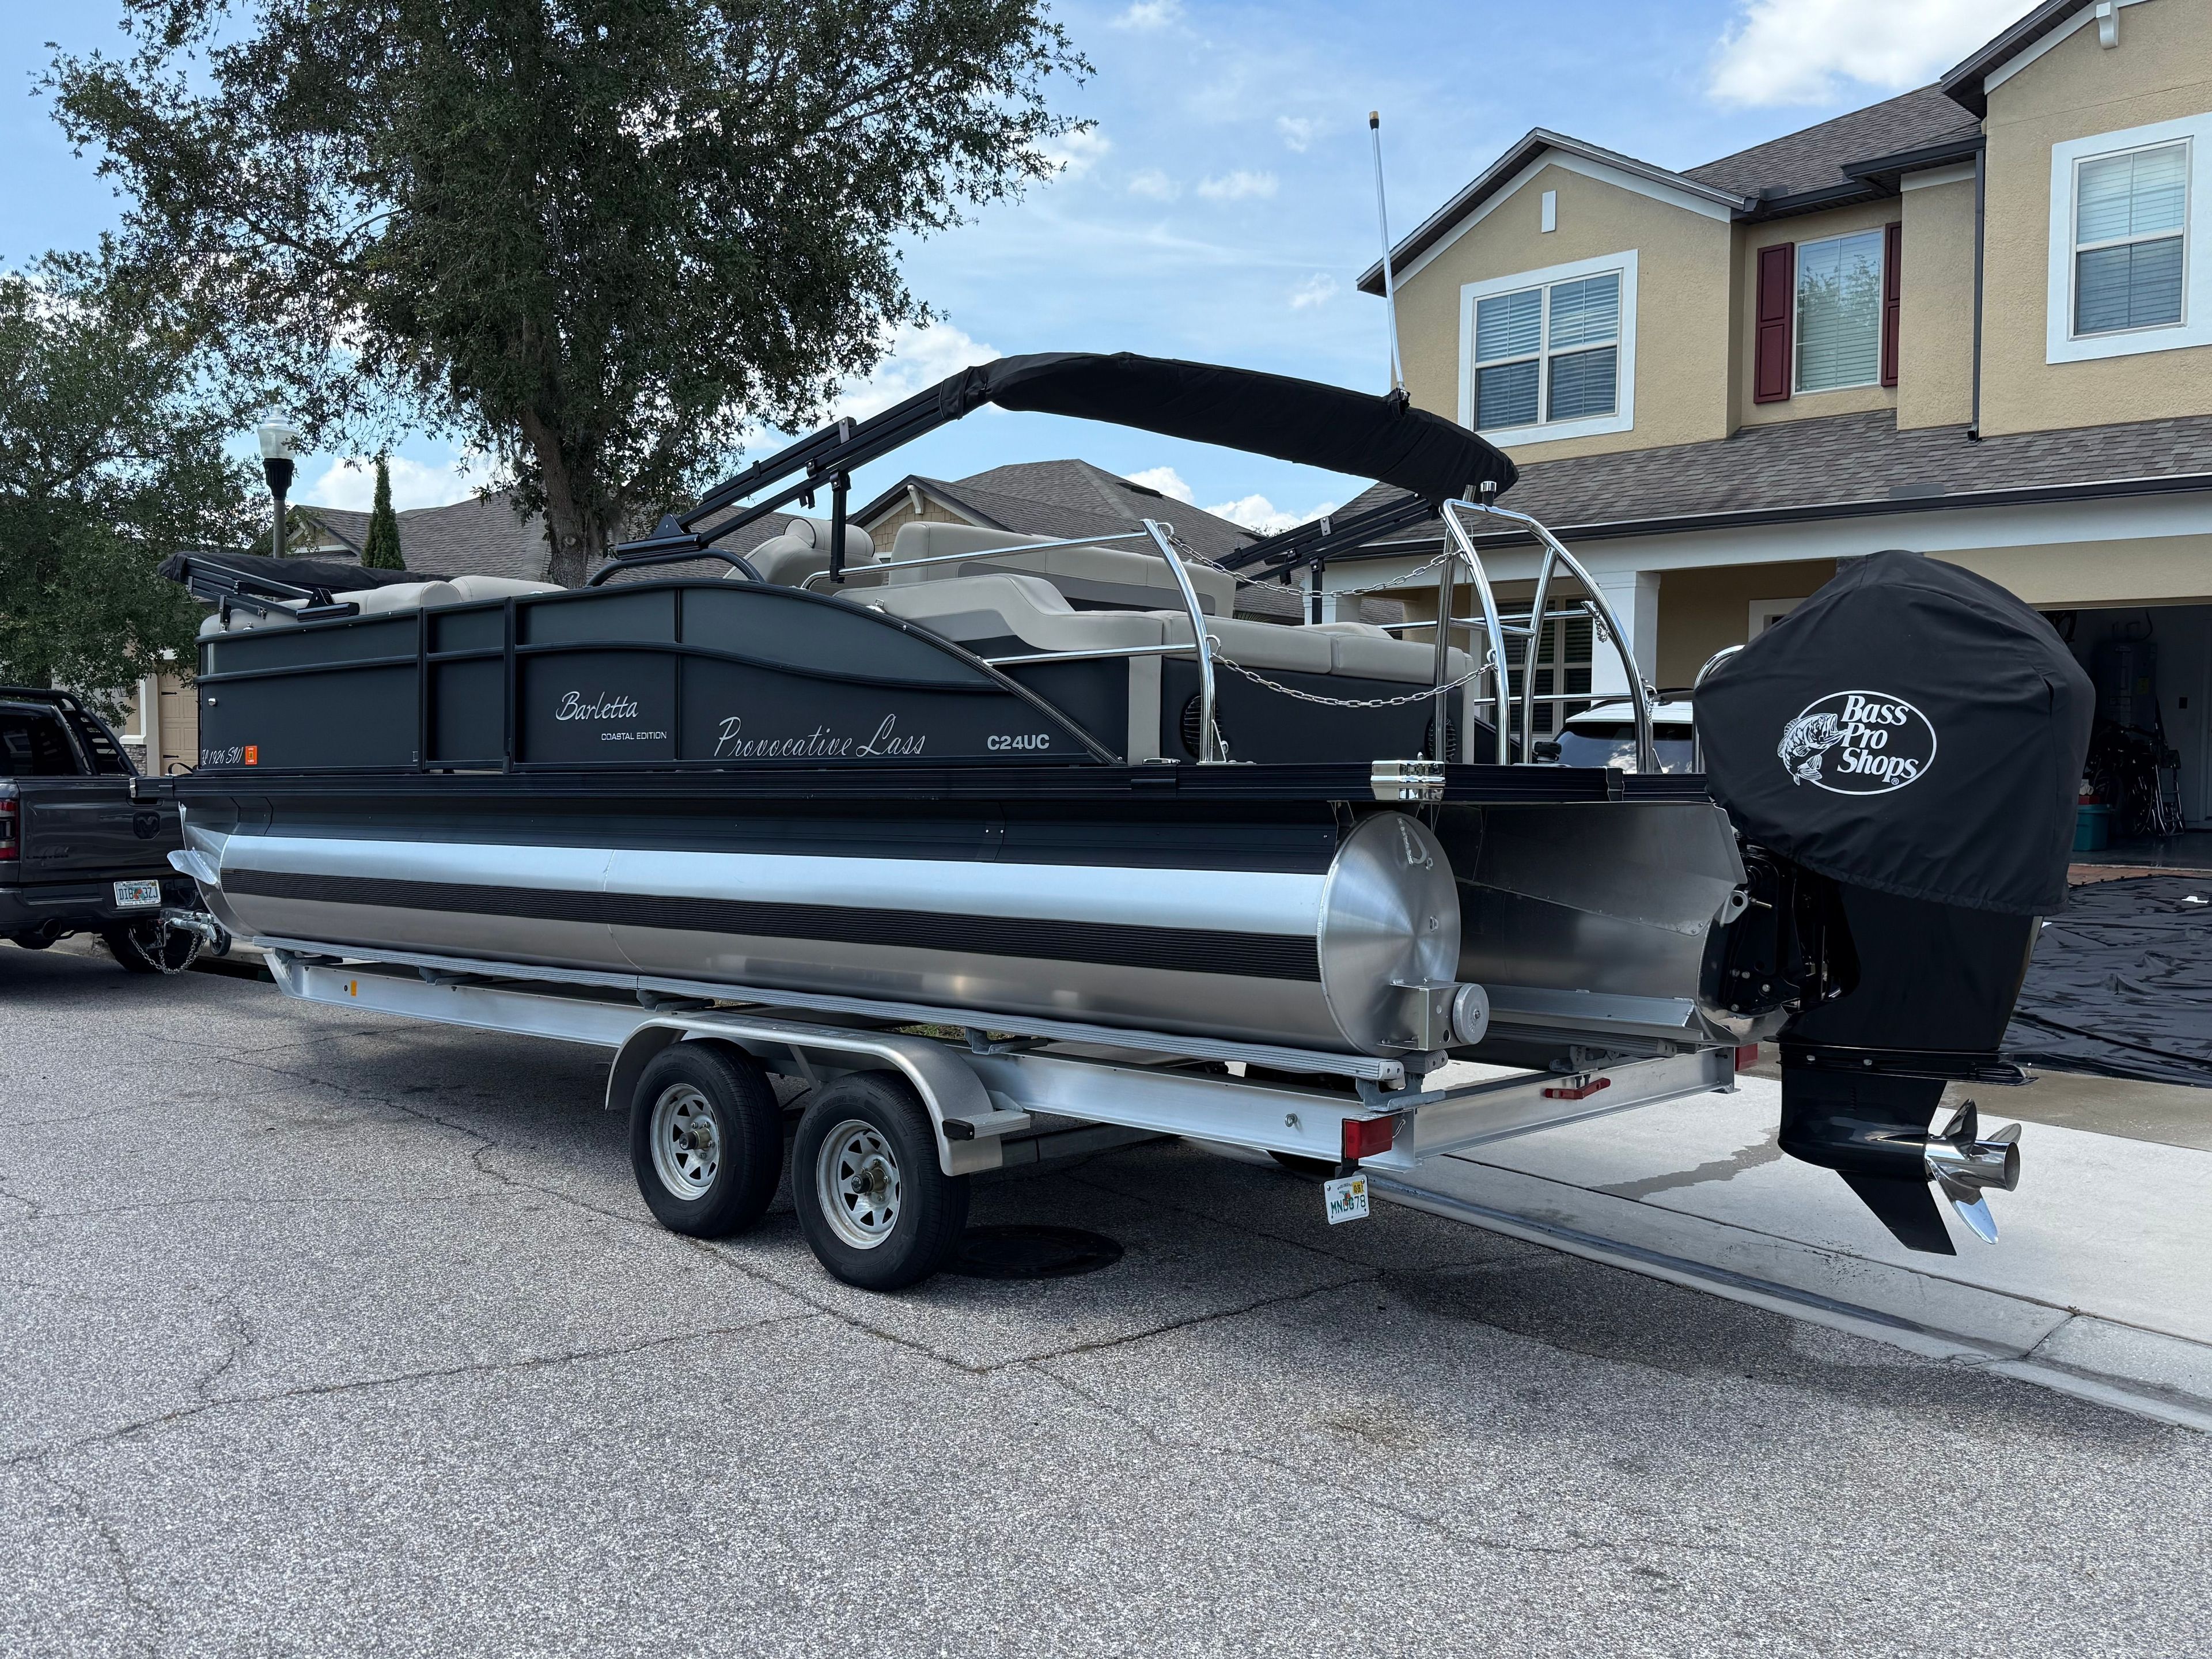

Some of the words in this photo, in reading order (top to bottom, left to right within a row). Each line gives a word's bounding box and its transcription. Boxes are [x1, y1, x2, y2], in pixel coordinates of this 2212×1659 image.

[556, 691, 638, 721] Barletta
[1840, 695, 1910, 726] Bass
[601, 732, 635, 741] COASTAL
[636, 731, 667, 740] EDITION
[714, 716, 852, 757] Provocative
[856, 714, 926, 757] Lass
[987, 734, 1050, 751] C24UC
[1840, 722, 1888, 749] Pro
[209, 750, 225, 764] 1926
[225, 747, 244, 764] SW
[1836, 747, 1919, 784] Shops
